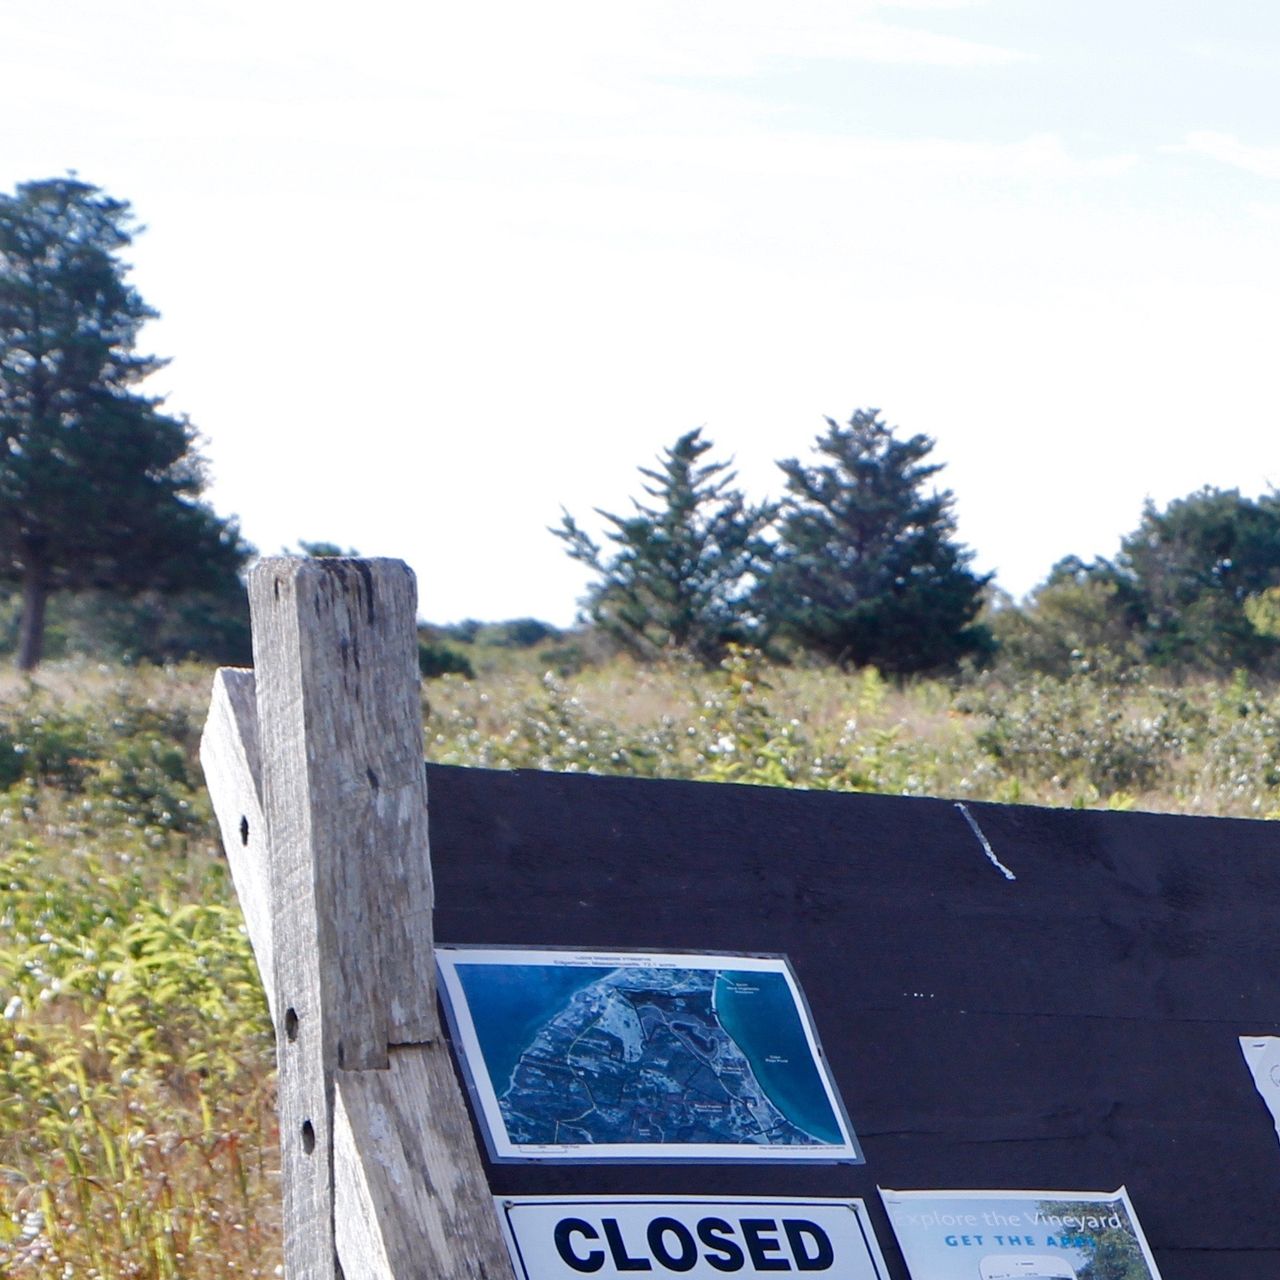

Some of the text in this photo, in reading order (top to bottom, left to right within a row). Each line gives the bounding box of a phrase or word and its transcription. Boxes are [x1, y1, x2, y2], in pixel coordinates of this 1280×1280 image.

[900, 1211, 1122, 1232] Explore the Vineyard
[554, 1217, 834, 1273] CLOSED
[945, 1235, 984, 1247] GET
[993, 1235, 1036, 1246] THE
